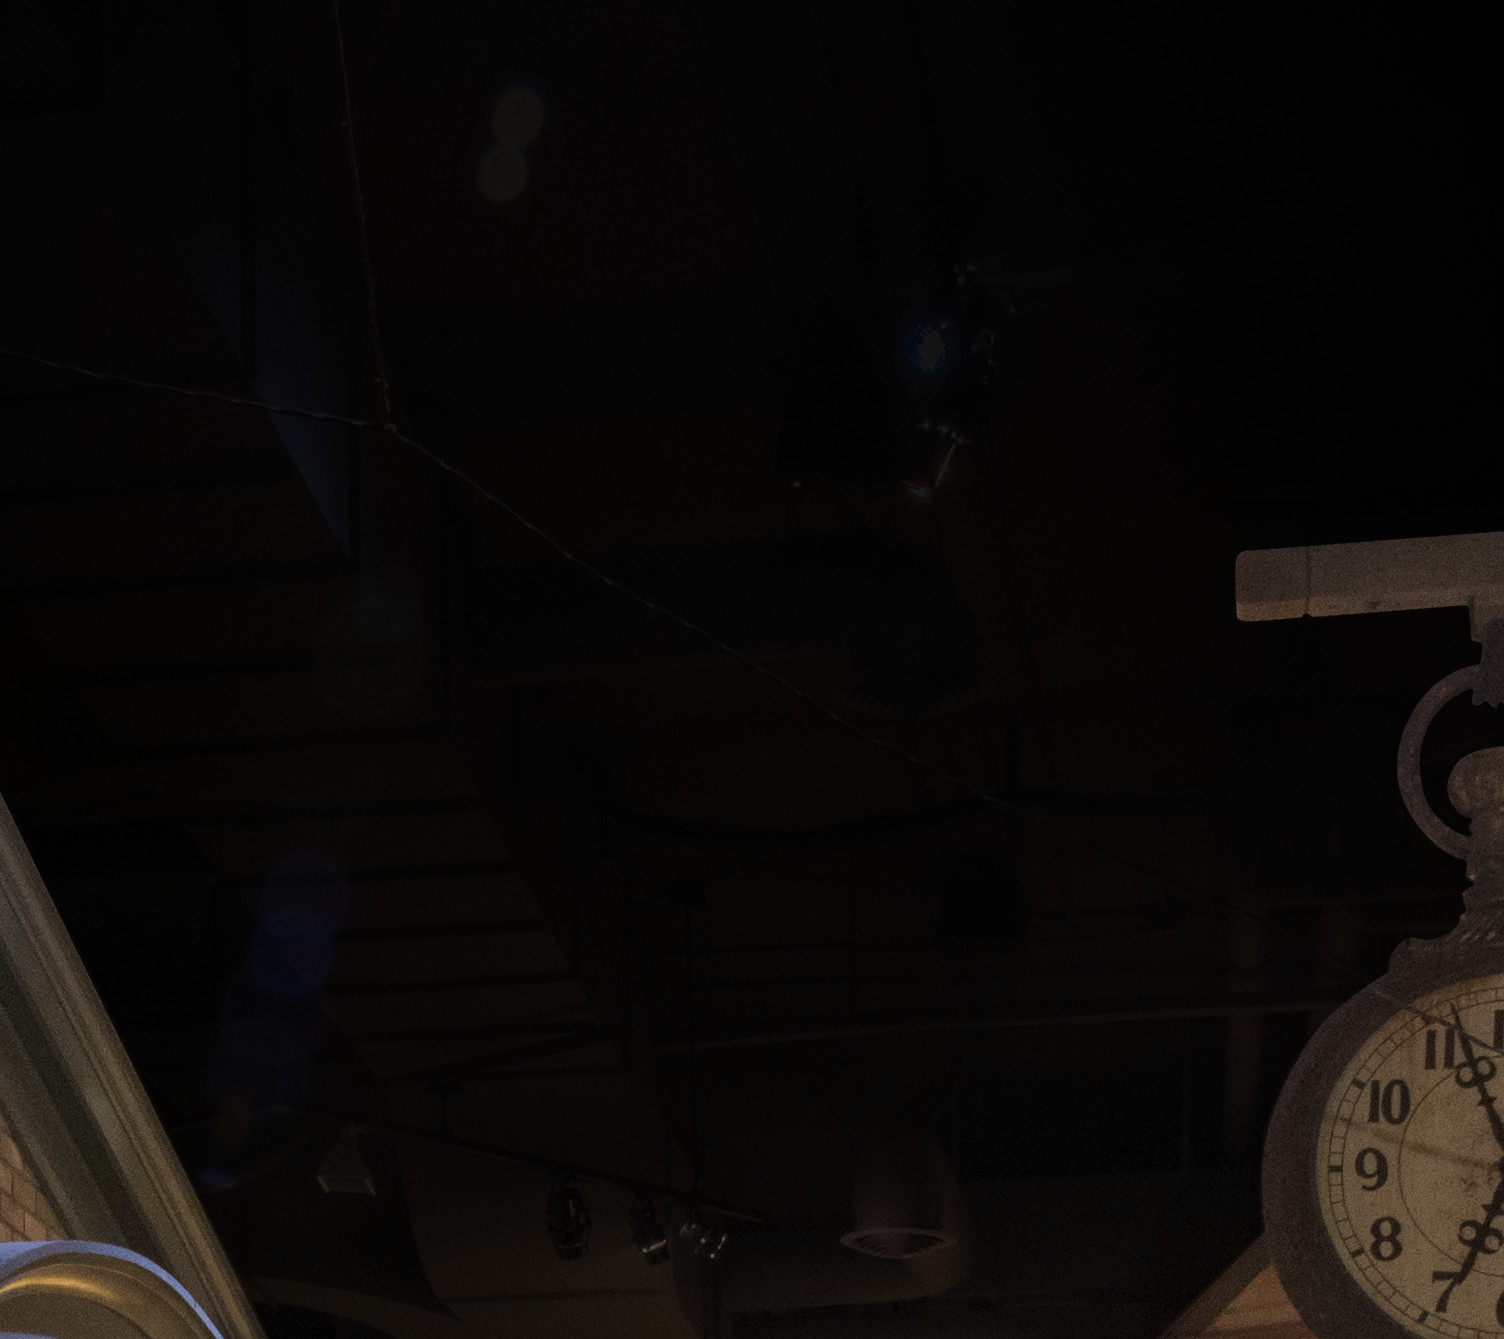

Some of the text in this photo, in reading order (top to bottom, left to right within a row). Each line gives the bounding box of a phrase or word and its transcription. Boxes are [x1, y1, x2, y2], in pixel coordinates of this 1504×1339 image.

[1425, 1029, 1455, 1070] 11
[1368, 1079, 1410, 1125] 10
[1355, 1148, 1388, 1191] 9
[1369, 1217, 1402, 1261] 8
[1432, 1270, 1462, 1313] 7
